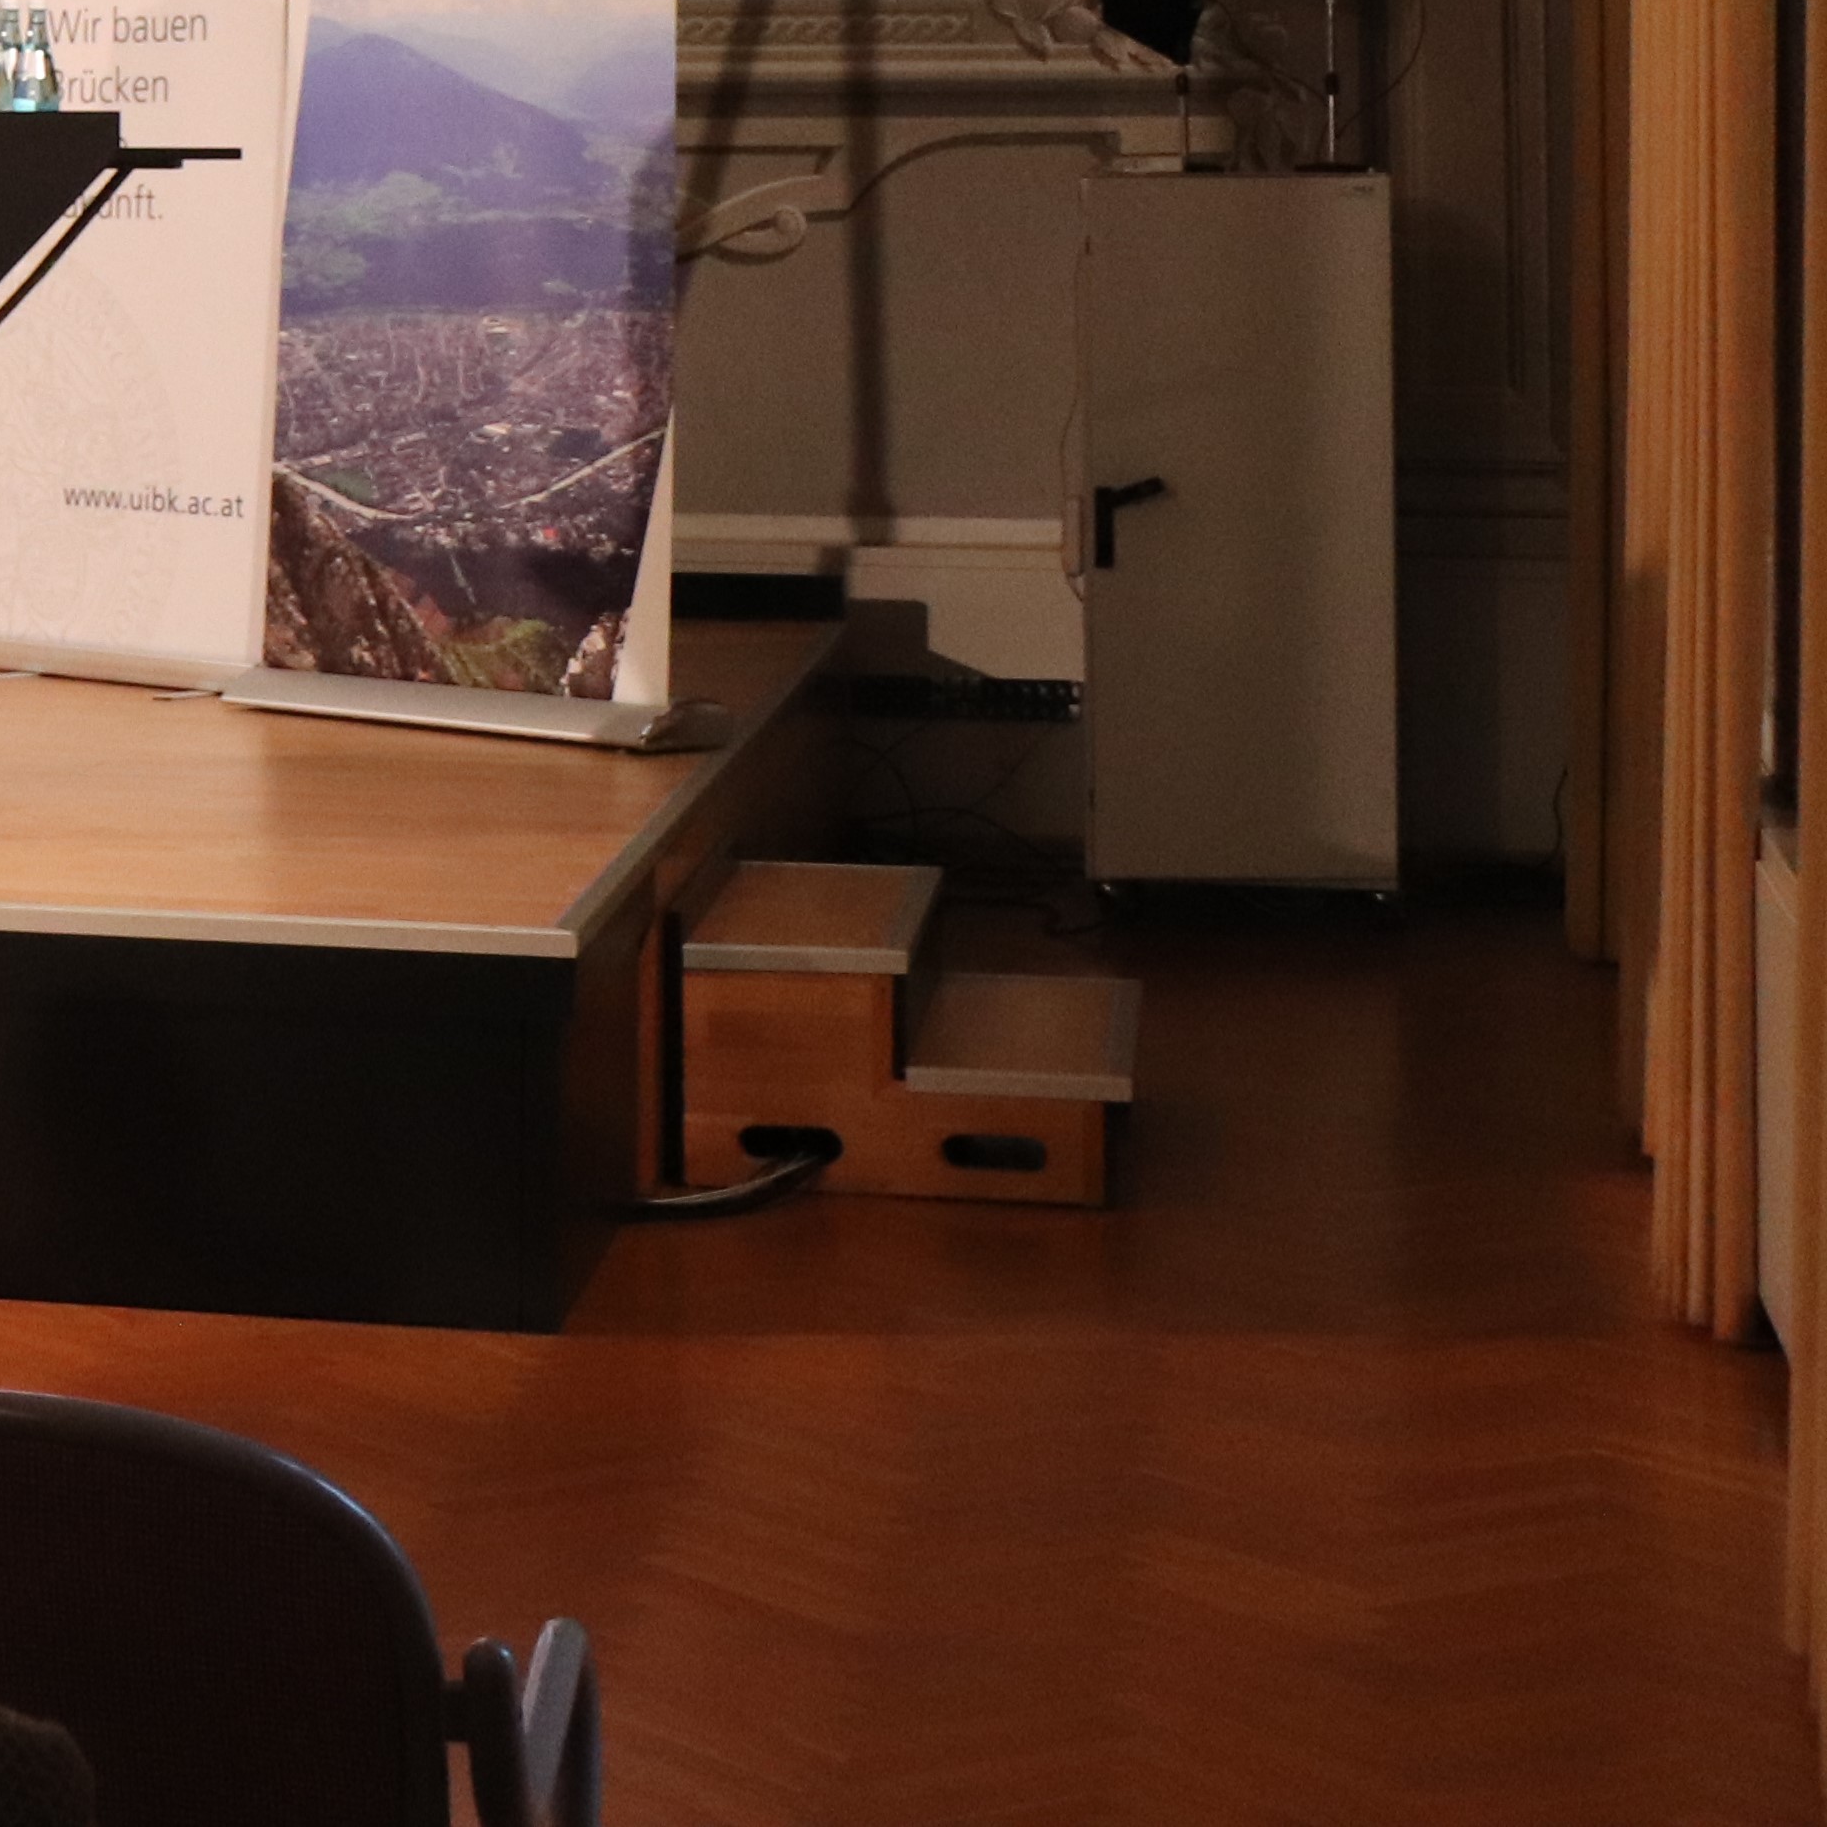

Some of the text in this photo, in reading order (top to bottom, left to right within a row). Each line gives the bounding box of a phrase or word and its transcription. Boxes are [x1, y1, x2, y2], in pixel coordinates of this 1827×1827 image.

[48, 6, 207, 44] Wir bauen
[63, 485, 244, 518] www.uibk.ac.at
